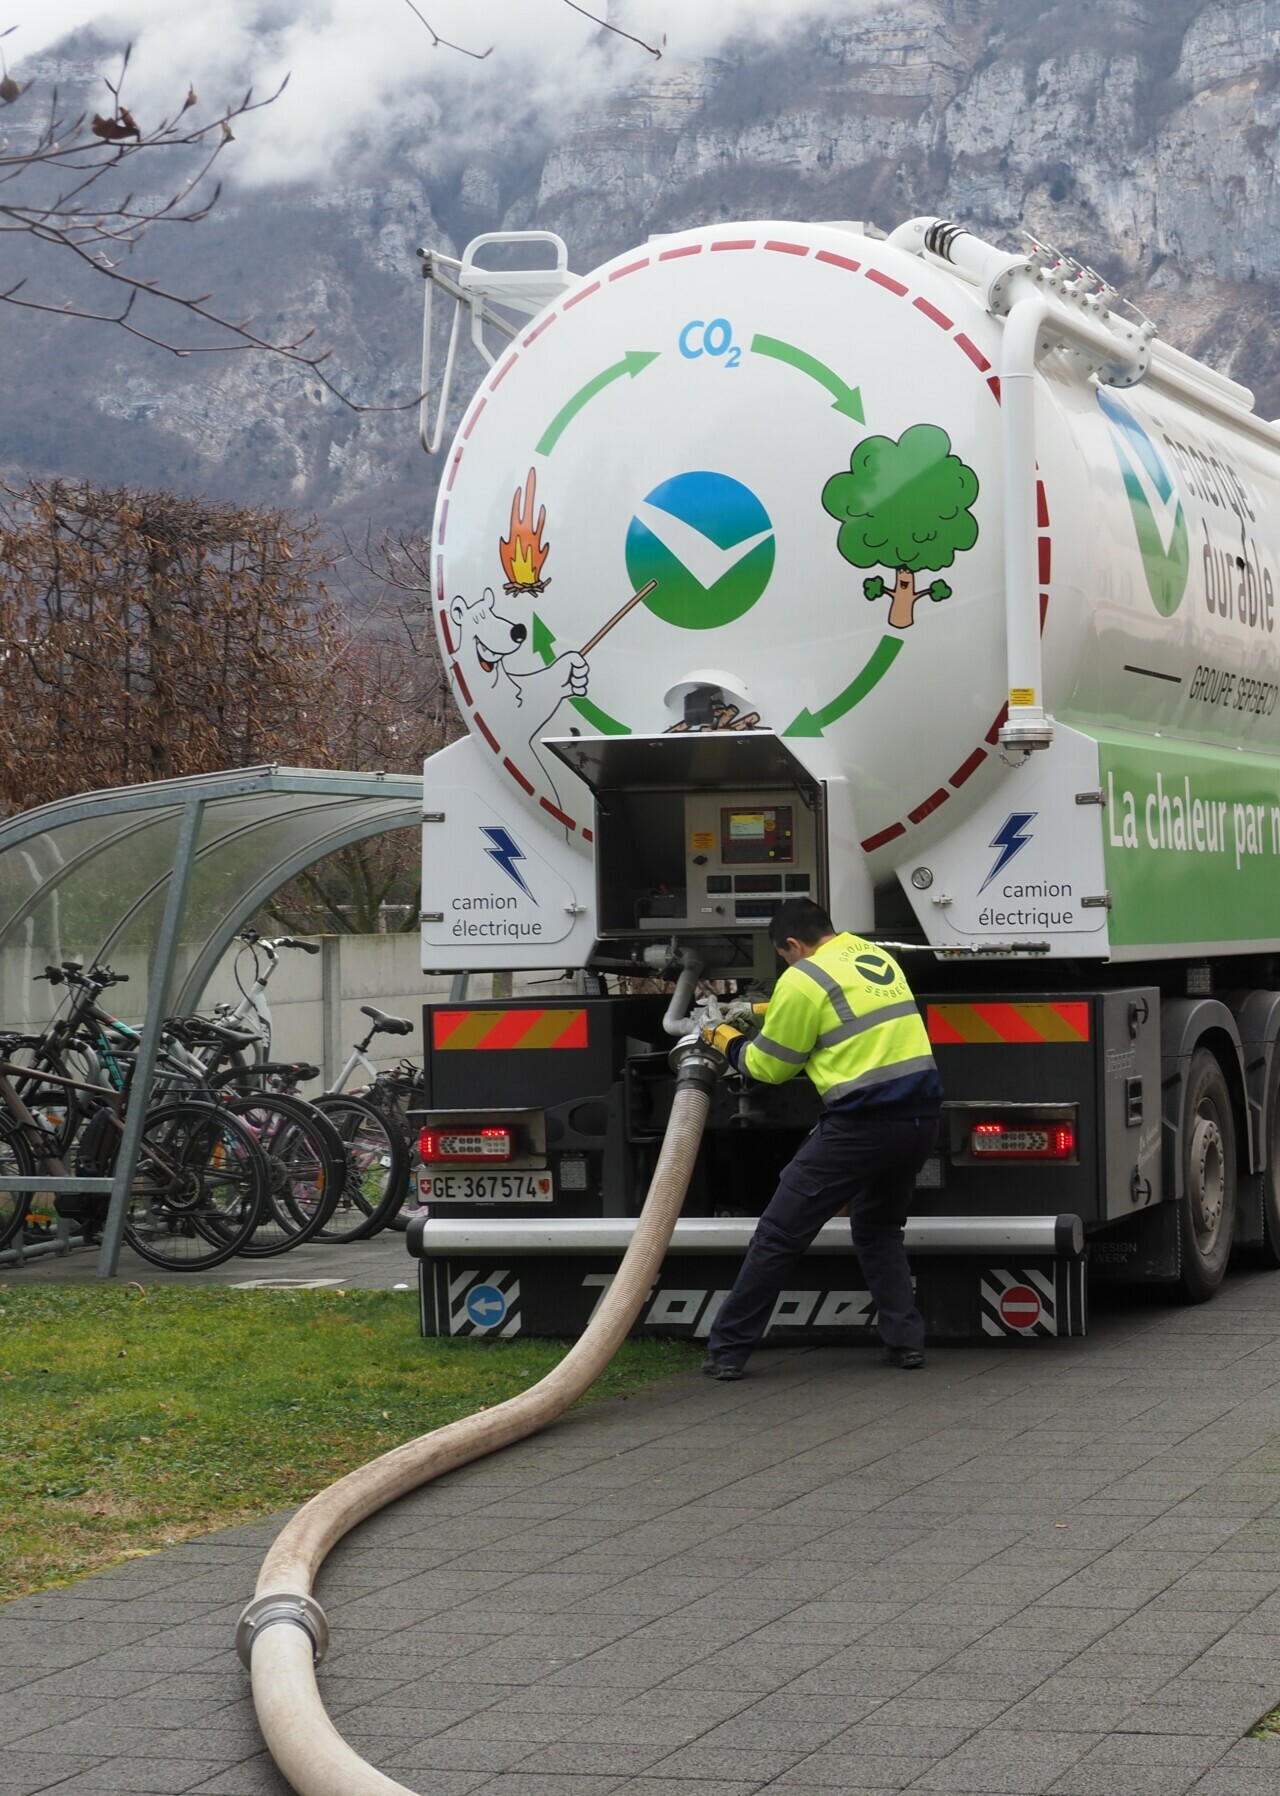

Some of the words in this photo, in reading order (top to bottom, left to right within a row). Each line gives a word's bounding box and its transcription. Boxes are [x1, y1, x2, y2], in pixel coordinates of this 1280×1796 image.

[1201, 516, 1274, 634] durable
[1189, 664, 1236, 707] GROUPE
[1107, 771, 1139, 849] La
[1145, 771, 1227, 852] chaleur
[1233, 802, 1265, 870] par
[1002, 880, 1073, 899] camion
[451, 892, 518, 910] camion
[451, 918, 543, 940] électrique
[978, 907, 1074, 929] électrique
